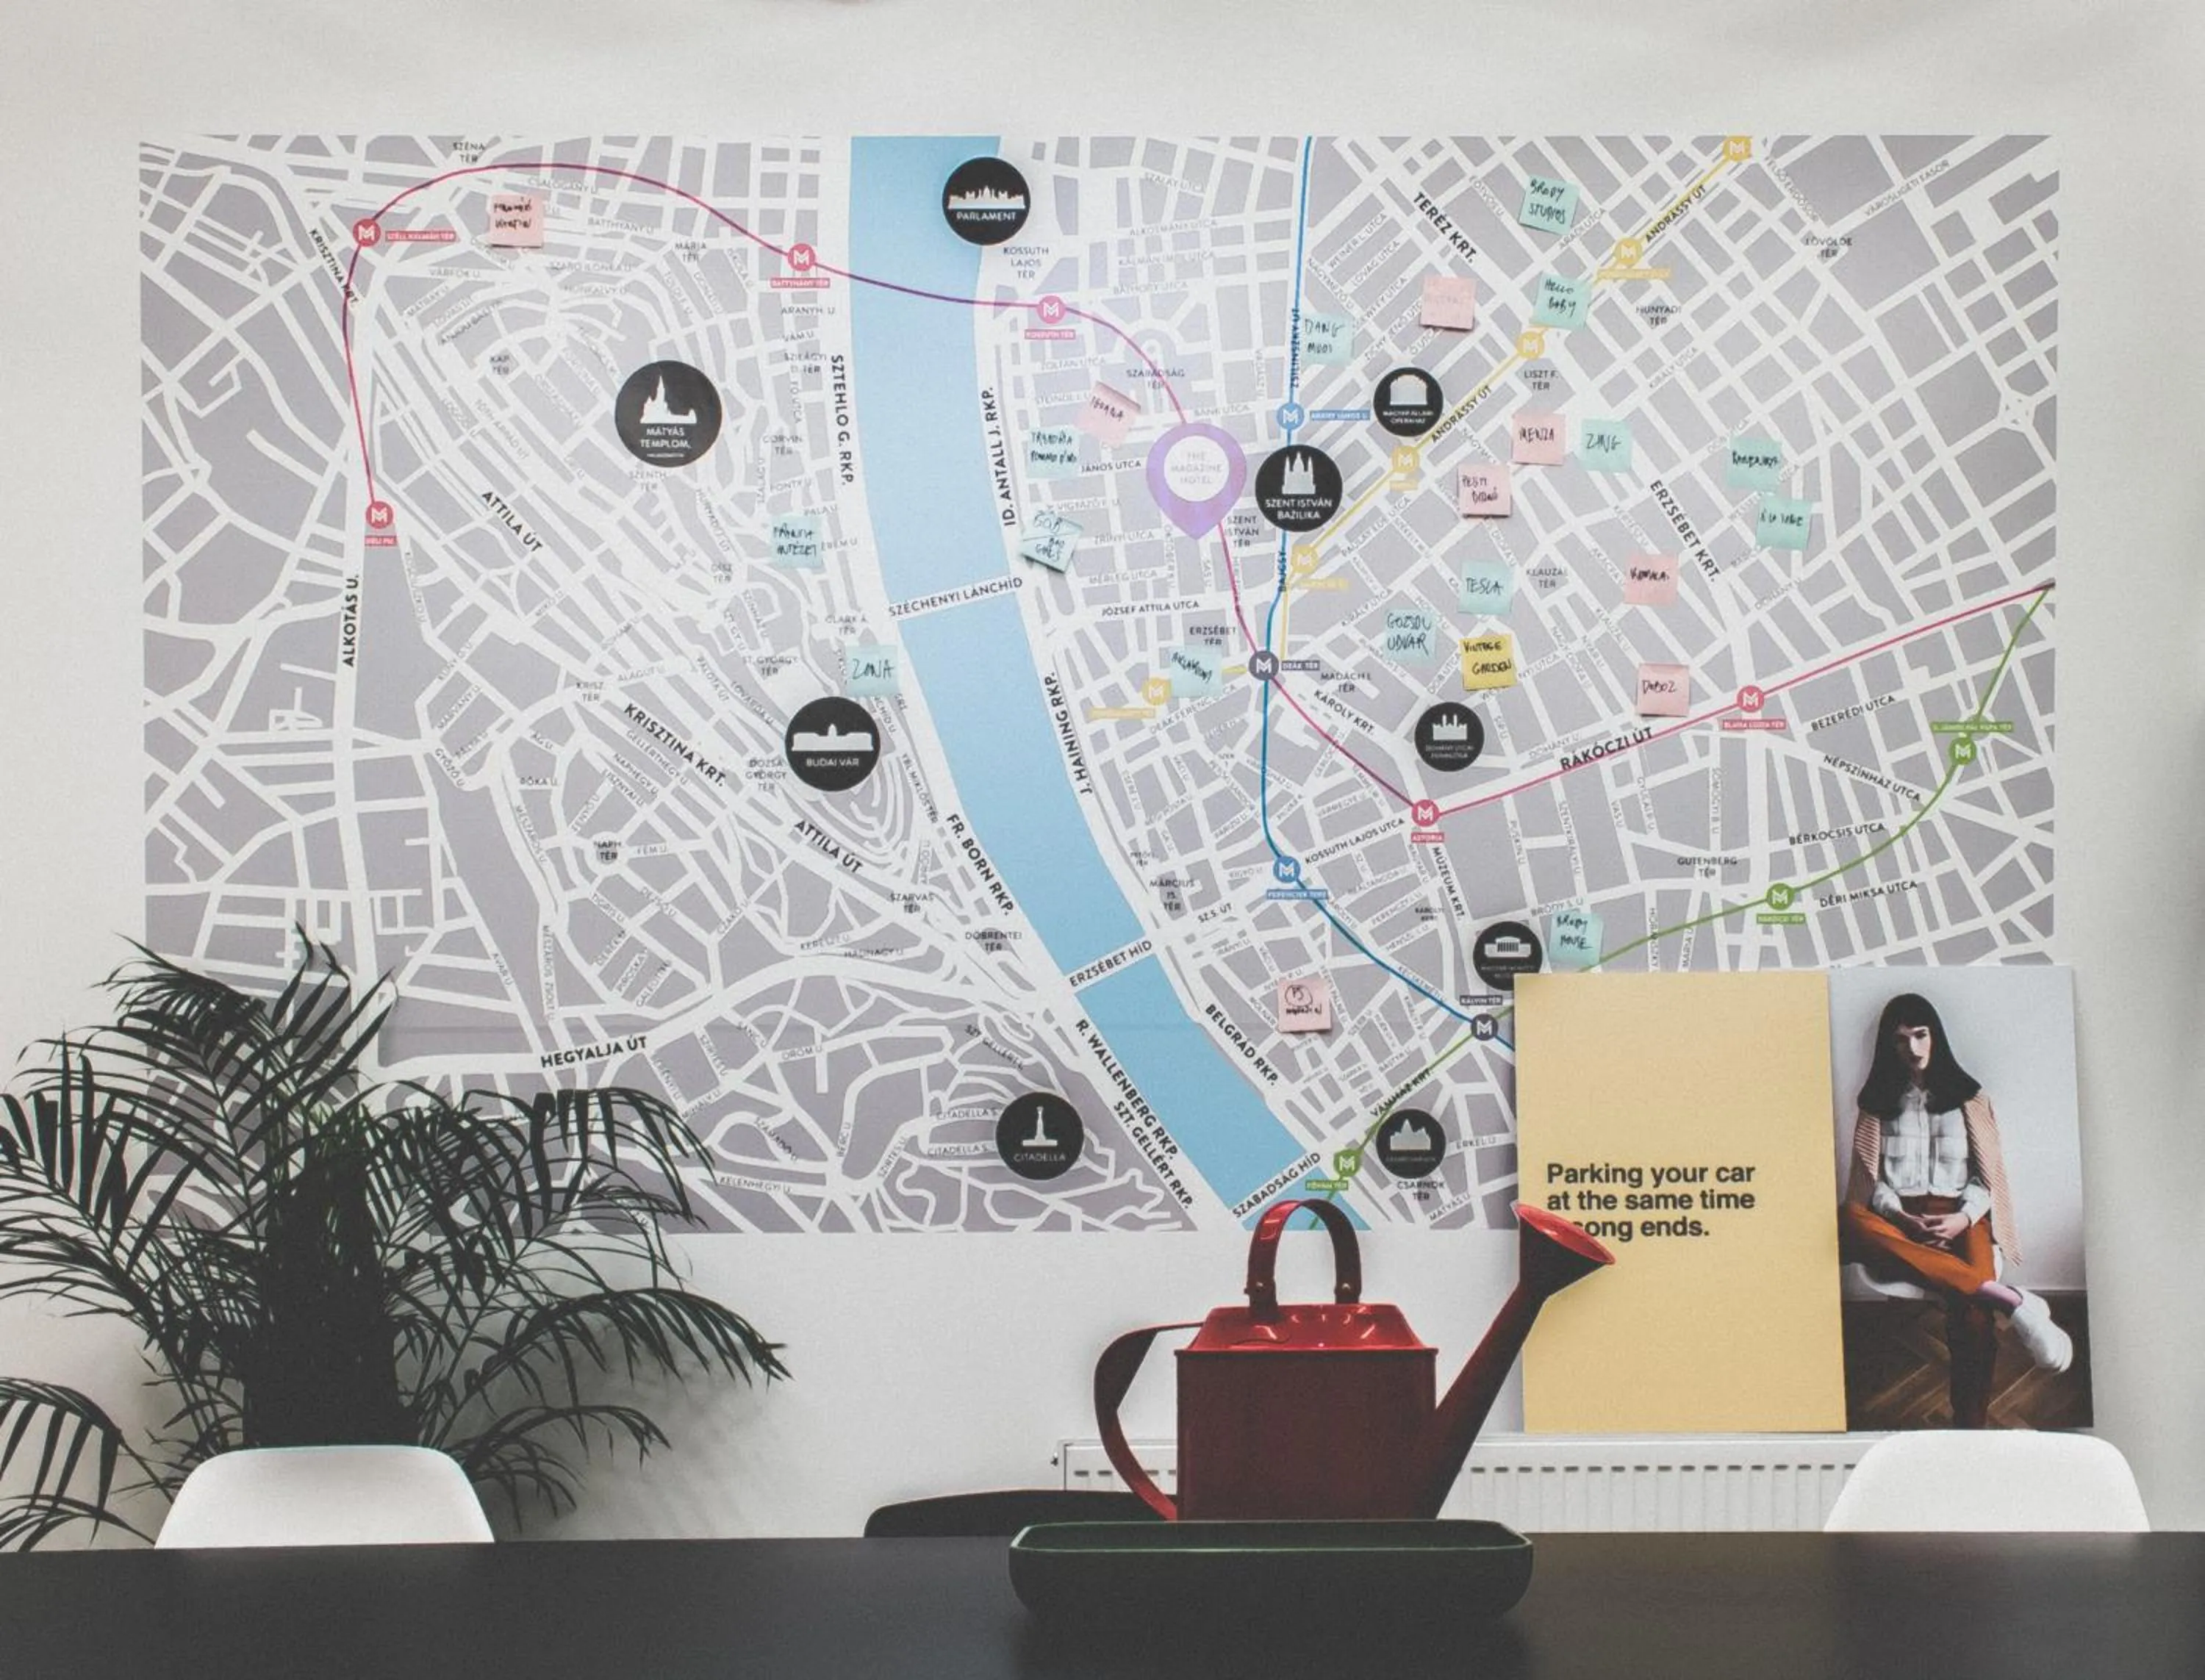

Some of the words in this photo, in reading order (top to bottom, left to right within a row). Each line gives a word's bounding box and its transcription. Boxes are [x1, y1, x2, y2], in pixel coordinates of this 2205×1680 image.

[956, 212, 1017, 221] PARLAMENT
[1413, 192, 1451, 234] TERÉZ
[1449, 231, 1477, 264] KRT.
[1646, 195, 1694, 243] ANDRÁSSY
[308, 227, 345, 286] KRISZTINA
[1003, 247, 1049, 255] KOSSUTH
[1011, 258, 1041, 267] LAJOS
[1017, 270, 1035, 279] TÉR
[831, 355, 849, 426] SZTEHLO
[981, 387, 1000, 421] RKP.
[647, 426, 684, 437] MÁTYÁS
[1431, 397, 1482, 443] ANDRÁSSY
[839, 450, 853, 485] RKP.
[989, 439, 1011, 500] ANTALL
[1171, 464, 1222, 473] MAGAZINE
[1266, 500, 1294, 508] SZENT
[1297, 498, 1332, 508] ISTVÁN
[1277, 510, 1321, 520] BAZILIKA
[481, 491, 523, 535] ATTILA
[523, 530, 543, 553] ÚT
[1650, 479, 1702, 551] ERZSÉBET
[1694, 546, 1721, 582] KRT.
[889, 592, 960, 617] SZÉCHENYI
[964, 577, 1022, 599] LÁNCHÍD
[1102, 605, 1136, 616] JÓZSEF
[1139, 603, 1171, 612] ATTILA
[1173, 600, 1199, 610] UTCA
[343, 592, 358, 667] ALKOTÁS
[1044, 672, 1066, 706] RKP.
[1865, 694, 1896, 712] UTCA
[624, 703, 694, 763] KRISZTINA
[695, 758, 726, 786] KRT.
[1056, 709, 1086, 779] HAINING
[1560, 737, 1632, 769] RÁKÓCZI
[1633, 728, 1653, 744] ÚT
[806, 758, 836, 767] BUDAI
[839, 758, 858, 767] VÁR
[1824, 755, 1890, 790] NÉPSZÍNHÁZ
[1892, 782, 1921, 802] UTCA
[795, 820, 839, 858] ATTILA
[842, 852, 864, 873] ÚT
[1305, 842, 1349, 865] KOSSUTH
[1349, 828, 1379, 848] LAJOS
[1379, 818, 1405, 834] UTCA
[1855, 822, 1885, 836] UTCA
[947, 814, 964, 839] FR.
[964, 840, 994, 881] BORN
[989, 880, 1014, 916] RKP.
[1699, 868, 1715, 878] TÉR
[1819, 894, 1847, 908] DÉRI
[1849, 887, 1885, 903] MIKSA
[1887, 880, 1918, 895] UTCA
[1069, 954, 1119, 987] ERZSÉBET
[1122, 941, 1152, 962] HÍD
[541, 1041, 624, 1069] HEGYALJA
[628, 1035, 647, 1051] ÚT
[1205, 1005, 1256, 1059] BELGRÁD
[1253, 1058, 1278, 1086] RKP.
[1087, 1038, 1155, 1128] WALLENBERG
[1153, 1123, 1179, 1160] RKP.
[1014, 1152, 1066, 1162] CITADELLA
[1113, 1101, 1131, 1129] SZT.
[1132, 1126, 1174, 1183] GELLÉRT
[1169, 1179, 1194, 1210] RKP.
[1233, 1168, 1299, 1218] SZABADSÁG
[1297, 1152, 1321, 1174] HÍD
[1547, 1163, 1643, 1188] Parking
[1651, 1166, 1709, 1188] your
[1715, 1166, 1756, 1182] car
[1413, 1192, 1430, 1201] TÉR
[1547, 1191, 1570, 1210] at
[1577, 1191, 1618, 1210] the
[1625, 1193, 1693, 1210] same
[1700, 1189, 1755, 1209] time
[1641, 1216, 1710, 1237] ends.
